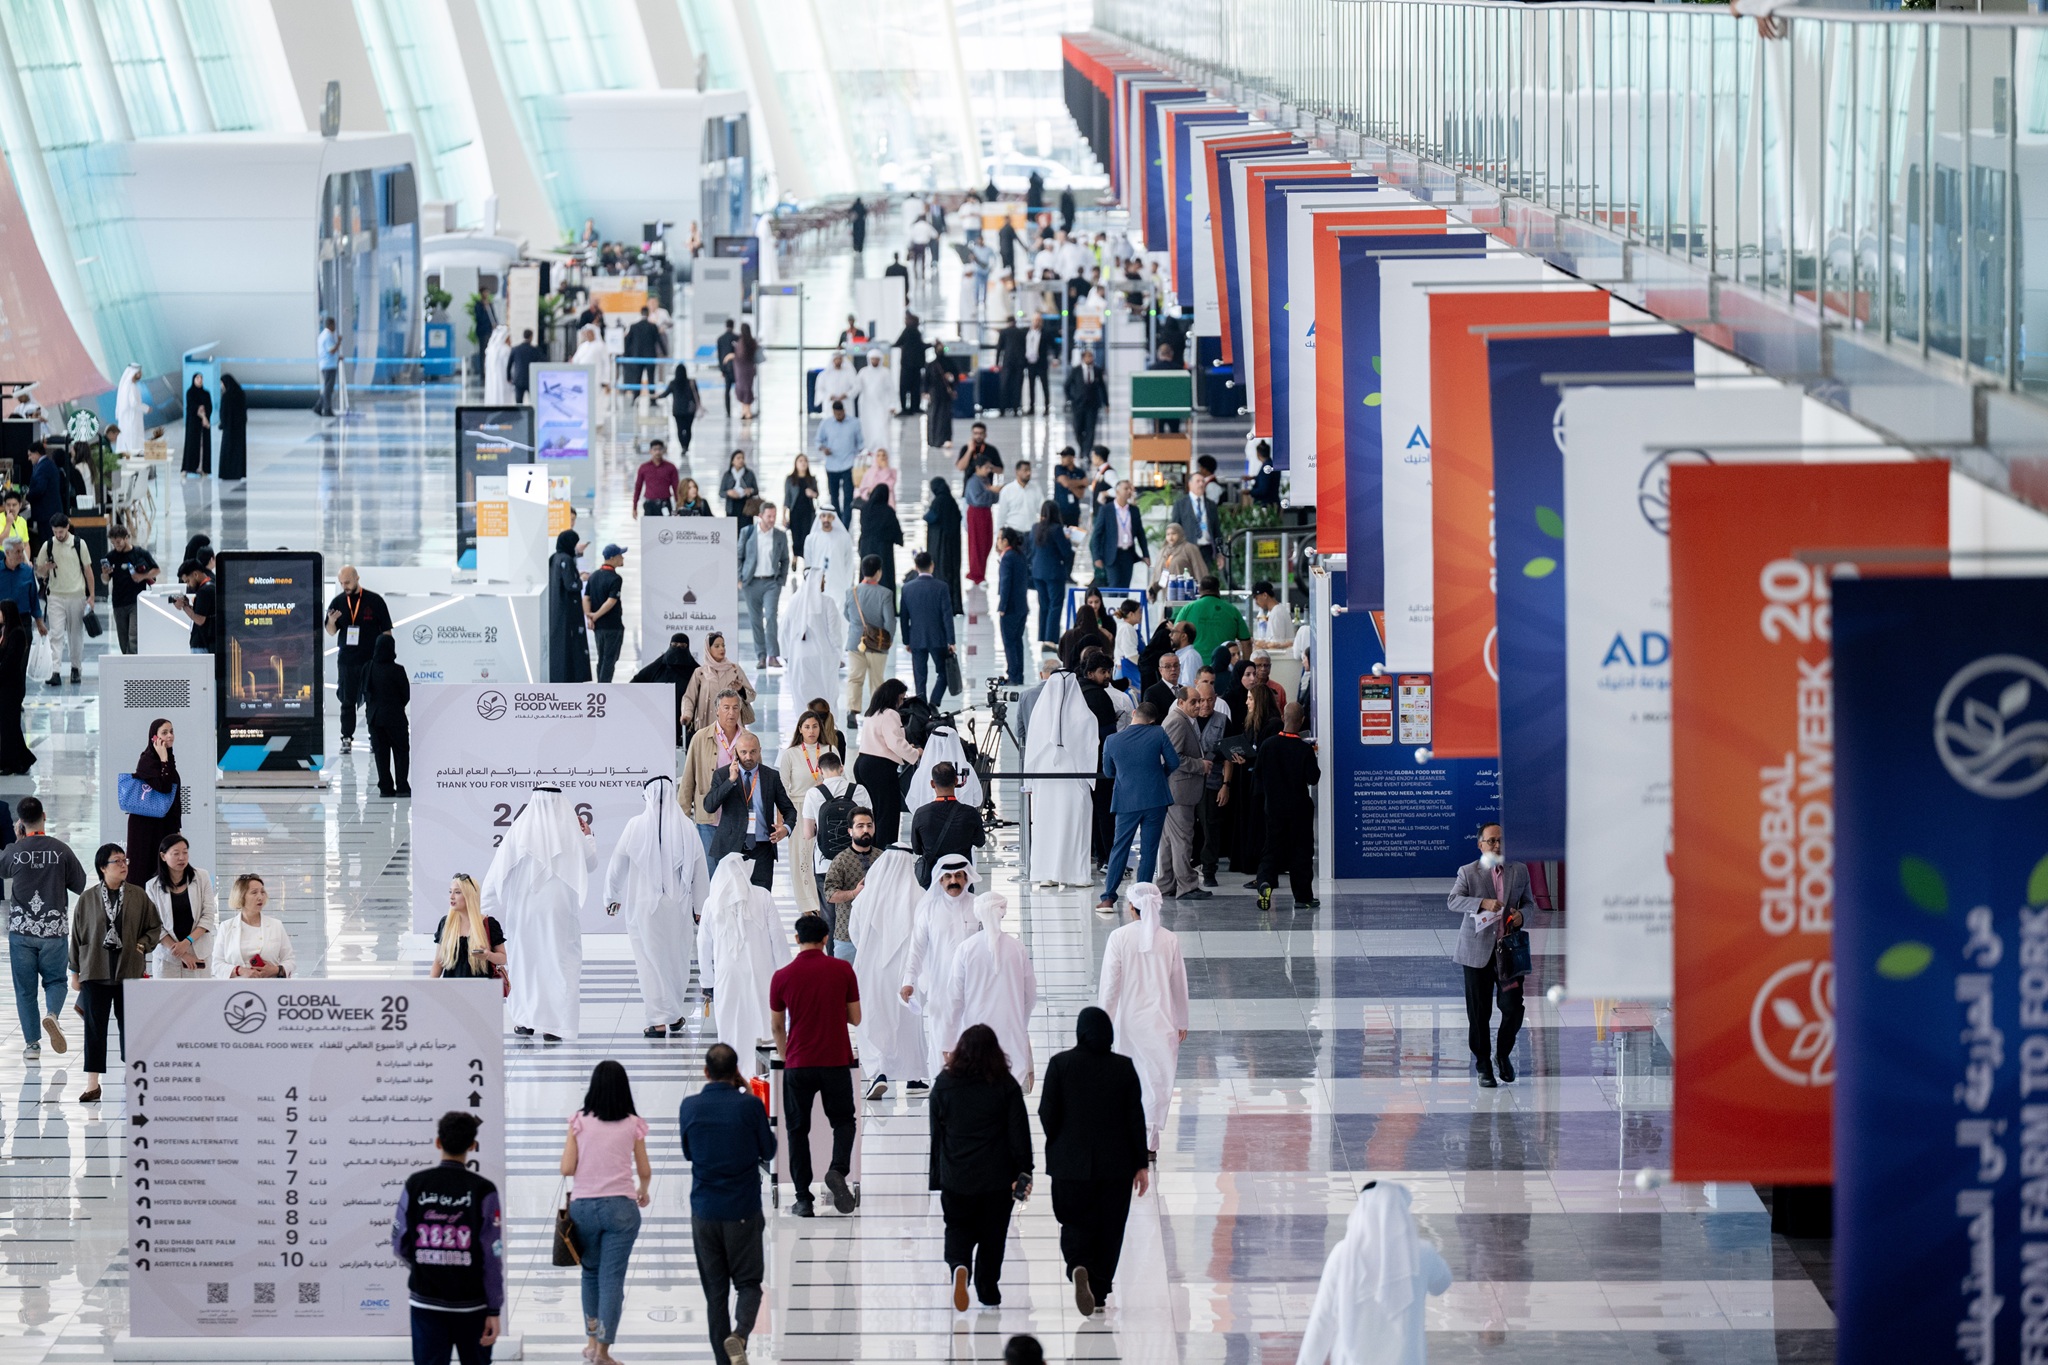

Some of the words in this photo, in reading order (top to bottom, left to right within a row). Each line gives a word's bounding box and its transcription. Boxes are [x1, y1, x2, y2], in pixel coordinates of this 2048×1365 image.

[254, 576, 293, 585] bitcoinmena
[1759, 556, 1812, 645] 20
[663, 612, 687, 620] الصلاة
[690, 612, 717, 620] منطقة
[485, 626, 498, 635] 20
[485, 634, 497, 643] 25
[413, 671, 443, 679] ADNEC
[514, 692, 559, 702] GLOBAL
[586, 693, 607, 705] 20
[514, 702, 547, 711] FOOD
[549, 702, 583, 711] WEEK
[586, 705, 606, 718] 25
[1796, 656, 1835, 796] WEEK
[1760, 752, 1796, 936] GLOBAL
[12, 850, 63, 866] SOFTLY
[1798, 799, 1835, 936] FOOD
[1962, 903, 2005, 968] من
[277, 994, 341, 1007] GLOBAL
[381, 995, 409, 1013] 20
[278, 1008, 324, 1020] FOOD
[327, 1008, 374, 1020] WEEK
[381, 1013, 408, 1031] 25
[345, 1041, 373, 1053] العالمي
[375, 1042, 404, 1052] الأسبوع
[406, 1042, 418, 1052] في
[420, 1041, 433, 1051] بكم
[1953, 970, 2005, 1114] المزرعة
[285, 1086, 298, 1102] 4
[286, 1106, 298, 1122] 5
[286, 1129, 298, 1145] 7
[286, 1149, 298, 1165] 7
[1955, 1117, 2008, 1184] إلى
[286, 1170, 298, 1185] 7
[285, 1189, 299, 1205] 8
[285, 1209, 299, 1225] 8
[447, 1211, 464, 1223] of
[286, 1229, 299, 1245] 9
[280, 1251, 304, 1267] 10
[415, 1249, 472, 1266] SENIORS
[360, 1299, 390, 1307] ADNEC
